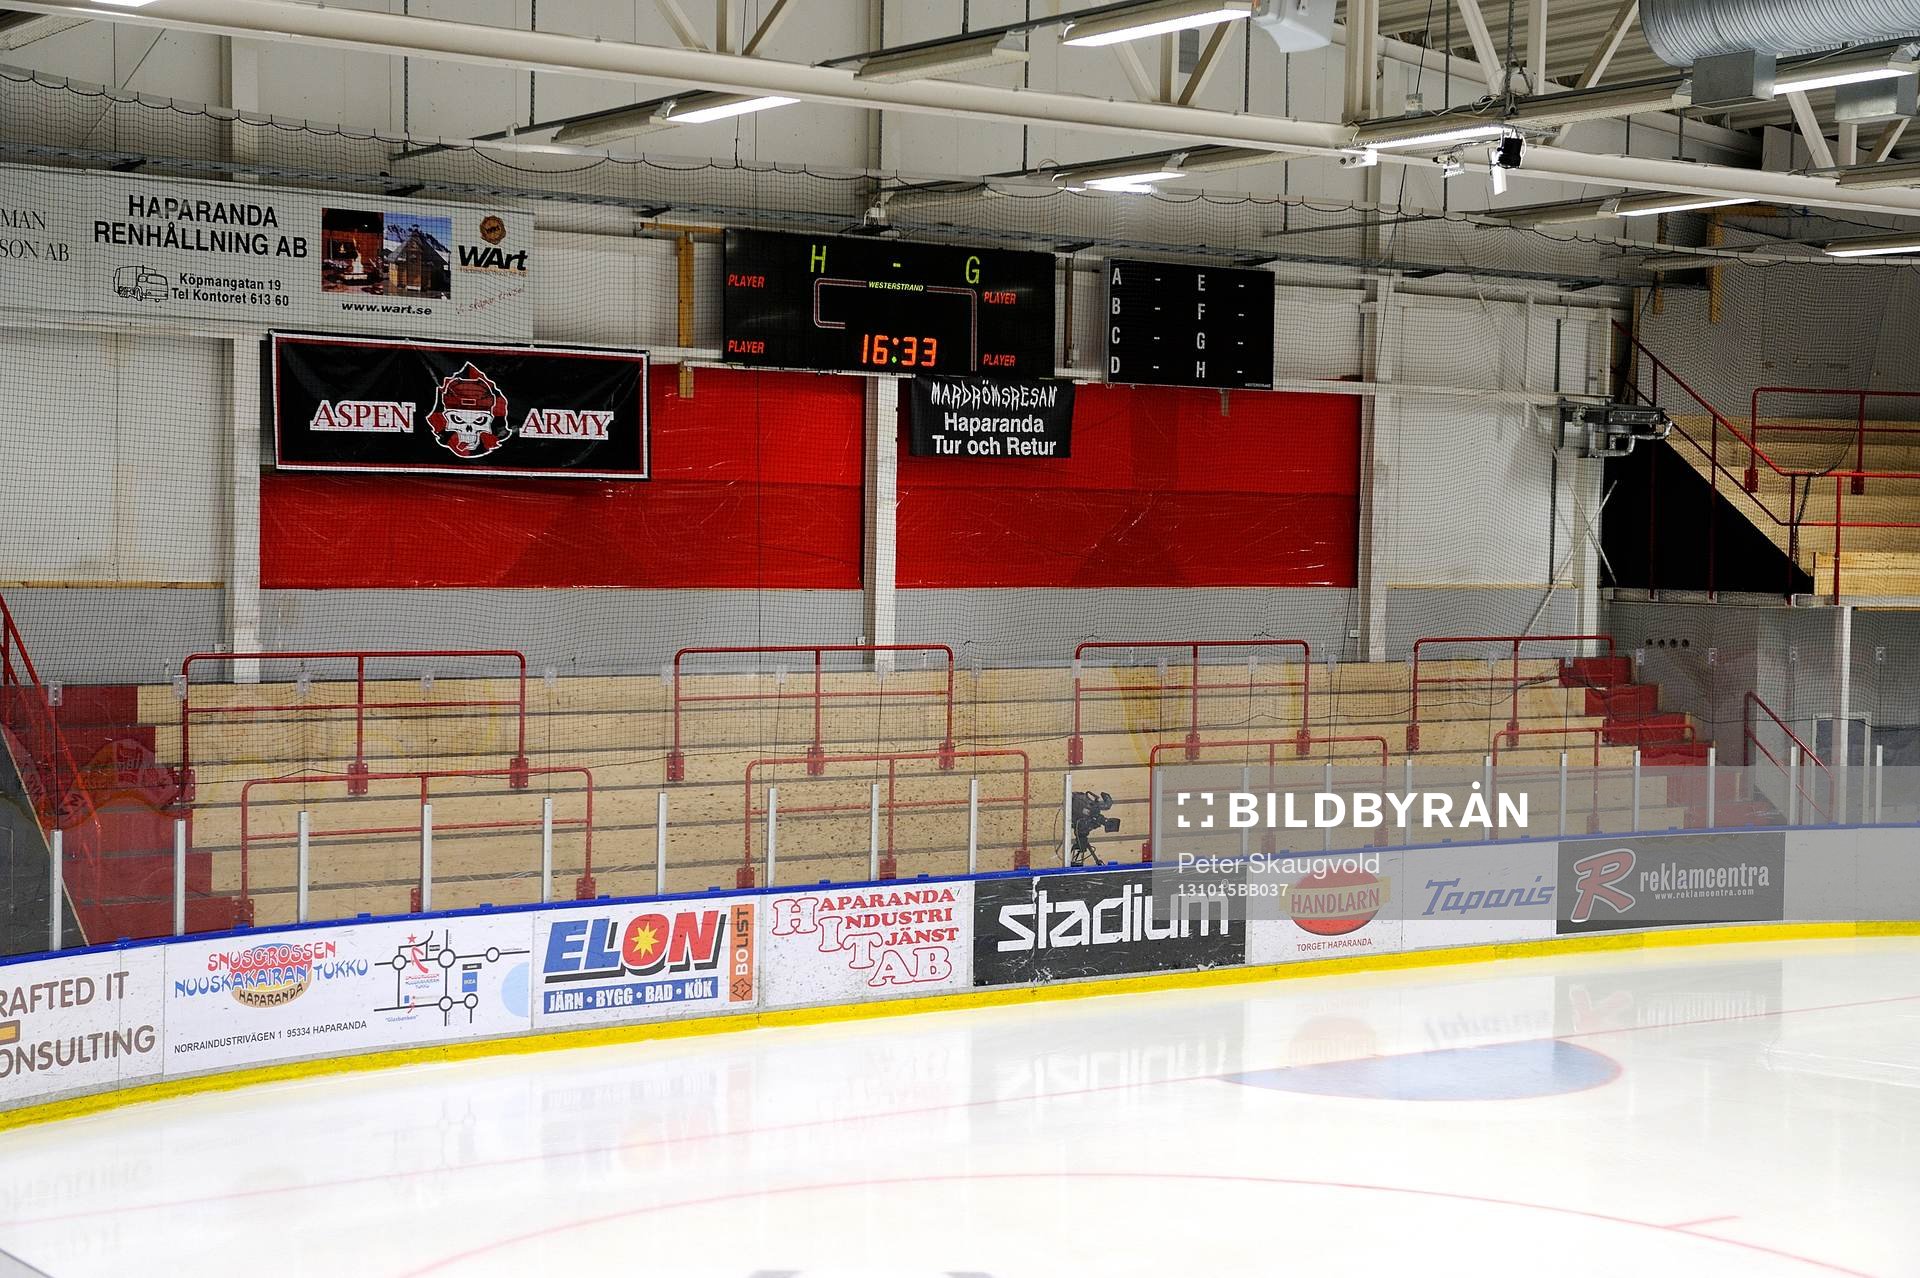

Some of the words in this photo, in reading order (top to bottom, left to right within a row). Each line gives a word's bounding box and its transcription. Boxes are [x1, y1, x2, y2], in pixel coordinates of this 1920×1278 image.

[128, 194, 278, 228] HAPARANDA
[94, 220, 269, 256] RENHÅLLNING
[275, 235, 308, 258] AB
[45, 243, 69, 261] AB
[458, 245, 528, 271] WArt
[810, 244, 826, 273] H
[965, 255, 980, 284] G
[179, 272, 264, 291] Köpmangatan
[268, 279, 281, 291] 19
[727, 273, 765, 289] PLAYER
[868, 280, 924, 292] WESTERSTRAND
[1112, 267, 1122, 285] A
[1197, 274, 1206, 291] E
[171, 287, 189, 300] Tel
[193, 288, 247, 304] Kontoret
[250, 293, 271, 306] 613
[275, 294, 289, 307] 60
[983, 291, 1017, 305] PLAYER
[1112, 297, 1121, 314] B
[341, 302, 433, 316] www.wart.se
[1197, 303, 1206, 320] F
[1111, 326, 1120, 344] C
[1196, 332, 1206, 349] G
[727, 339, 765, 354] PLAYER
[861, 333, 937, 367] 16:33
[983, 353, 1016, 367] PLAYER
[1111, 356, 1120, 374] D
[1196, 361, 1206, 378] H
[311, 400, 415, 432] ASPEN
[520, 408, 614, 440] ARMY
[944, 412, 1045, 436] Haparanda
[932, 435, 962, 454] Tur
[967, 437, 1001, 455] och
[1007, 437, 1057, 455] Retur
[1639, 862, 1770, 892] reklamcentra
[1422, 876, 1556, 916] Tapanis
[1655, 888, 1754, 900] www.reklamcentra.com
[997, 883, 1229, 952] stadium
[543, 910, 727, 984] ELON
[736, 907, 749, 976] BOLIST
[1296, 941, 1326, 952] TORGET
[1327, 938, 1372, 949] HAPARANDA
[207, 941, 336, 972] SNUSGROSSEN
[868, 946, 953, 987] AB
[106, 971, 129, 1001] IT
[175, 966, 307, 998] NUUSKAKAIRAN
[313, 959, 368, 981] TUKKU
[239, 983, 303, 1005] HAPARANDA
[548, 992, 583, 1012] JÄRN
[596, 988, 633, 1007] BYGG
[645, 984, 673, 1001] BAD
[684, 979, 713, 999] KÖK
[278, 1030, 283, 1039] 1
[287, 1028, 311, 1038] 95334
[312, 1020, 367, 1035] HAPARANDA
